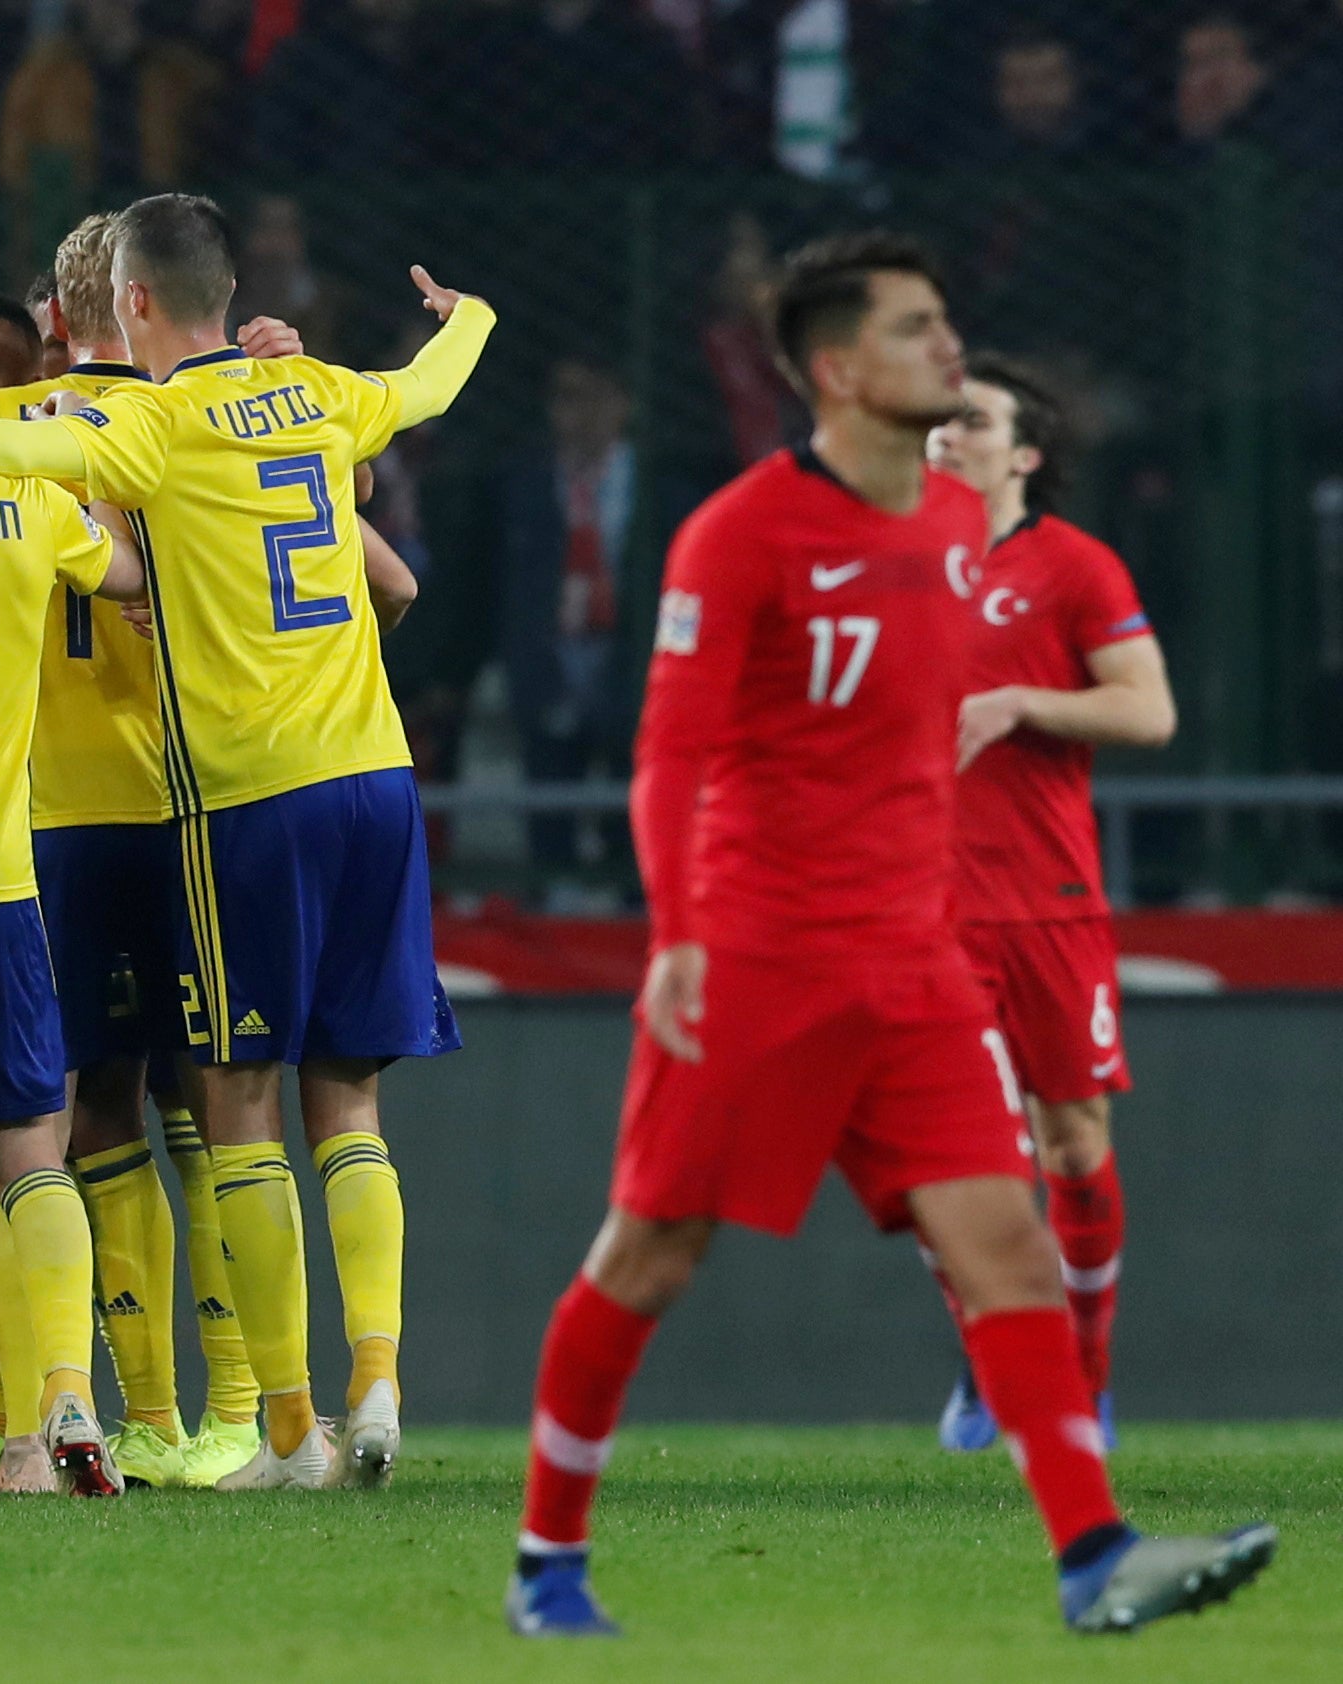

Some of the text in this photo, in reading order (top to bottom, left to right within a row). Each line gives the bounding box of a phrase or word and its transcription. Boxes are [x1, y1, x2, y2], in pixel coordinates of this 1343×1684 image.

[257, 454, 353, 632] 2
[807, 616, 881, 707] 17
[179, 974, 210, 1045] 2
[233, 1025, 271, 1035] adidas
